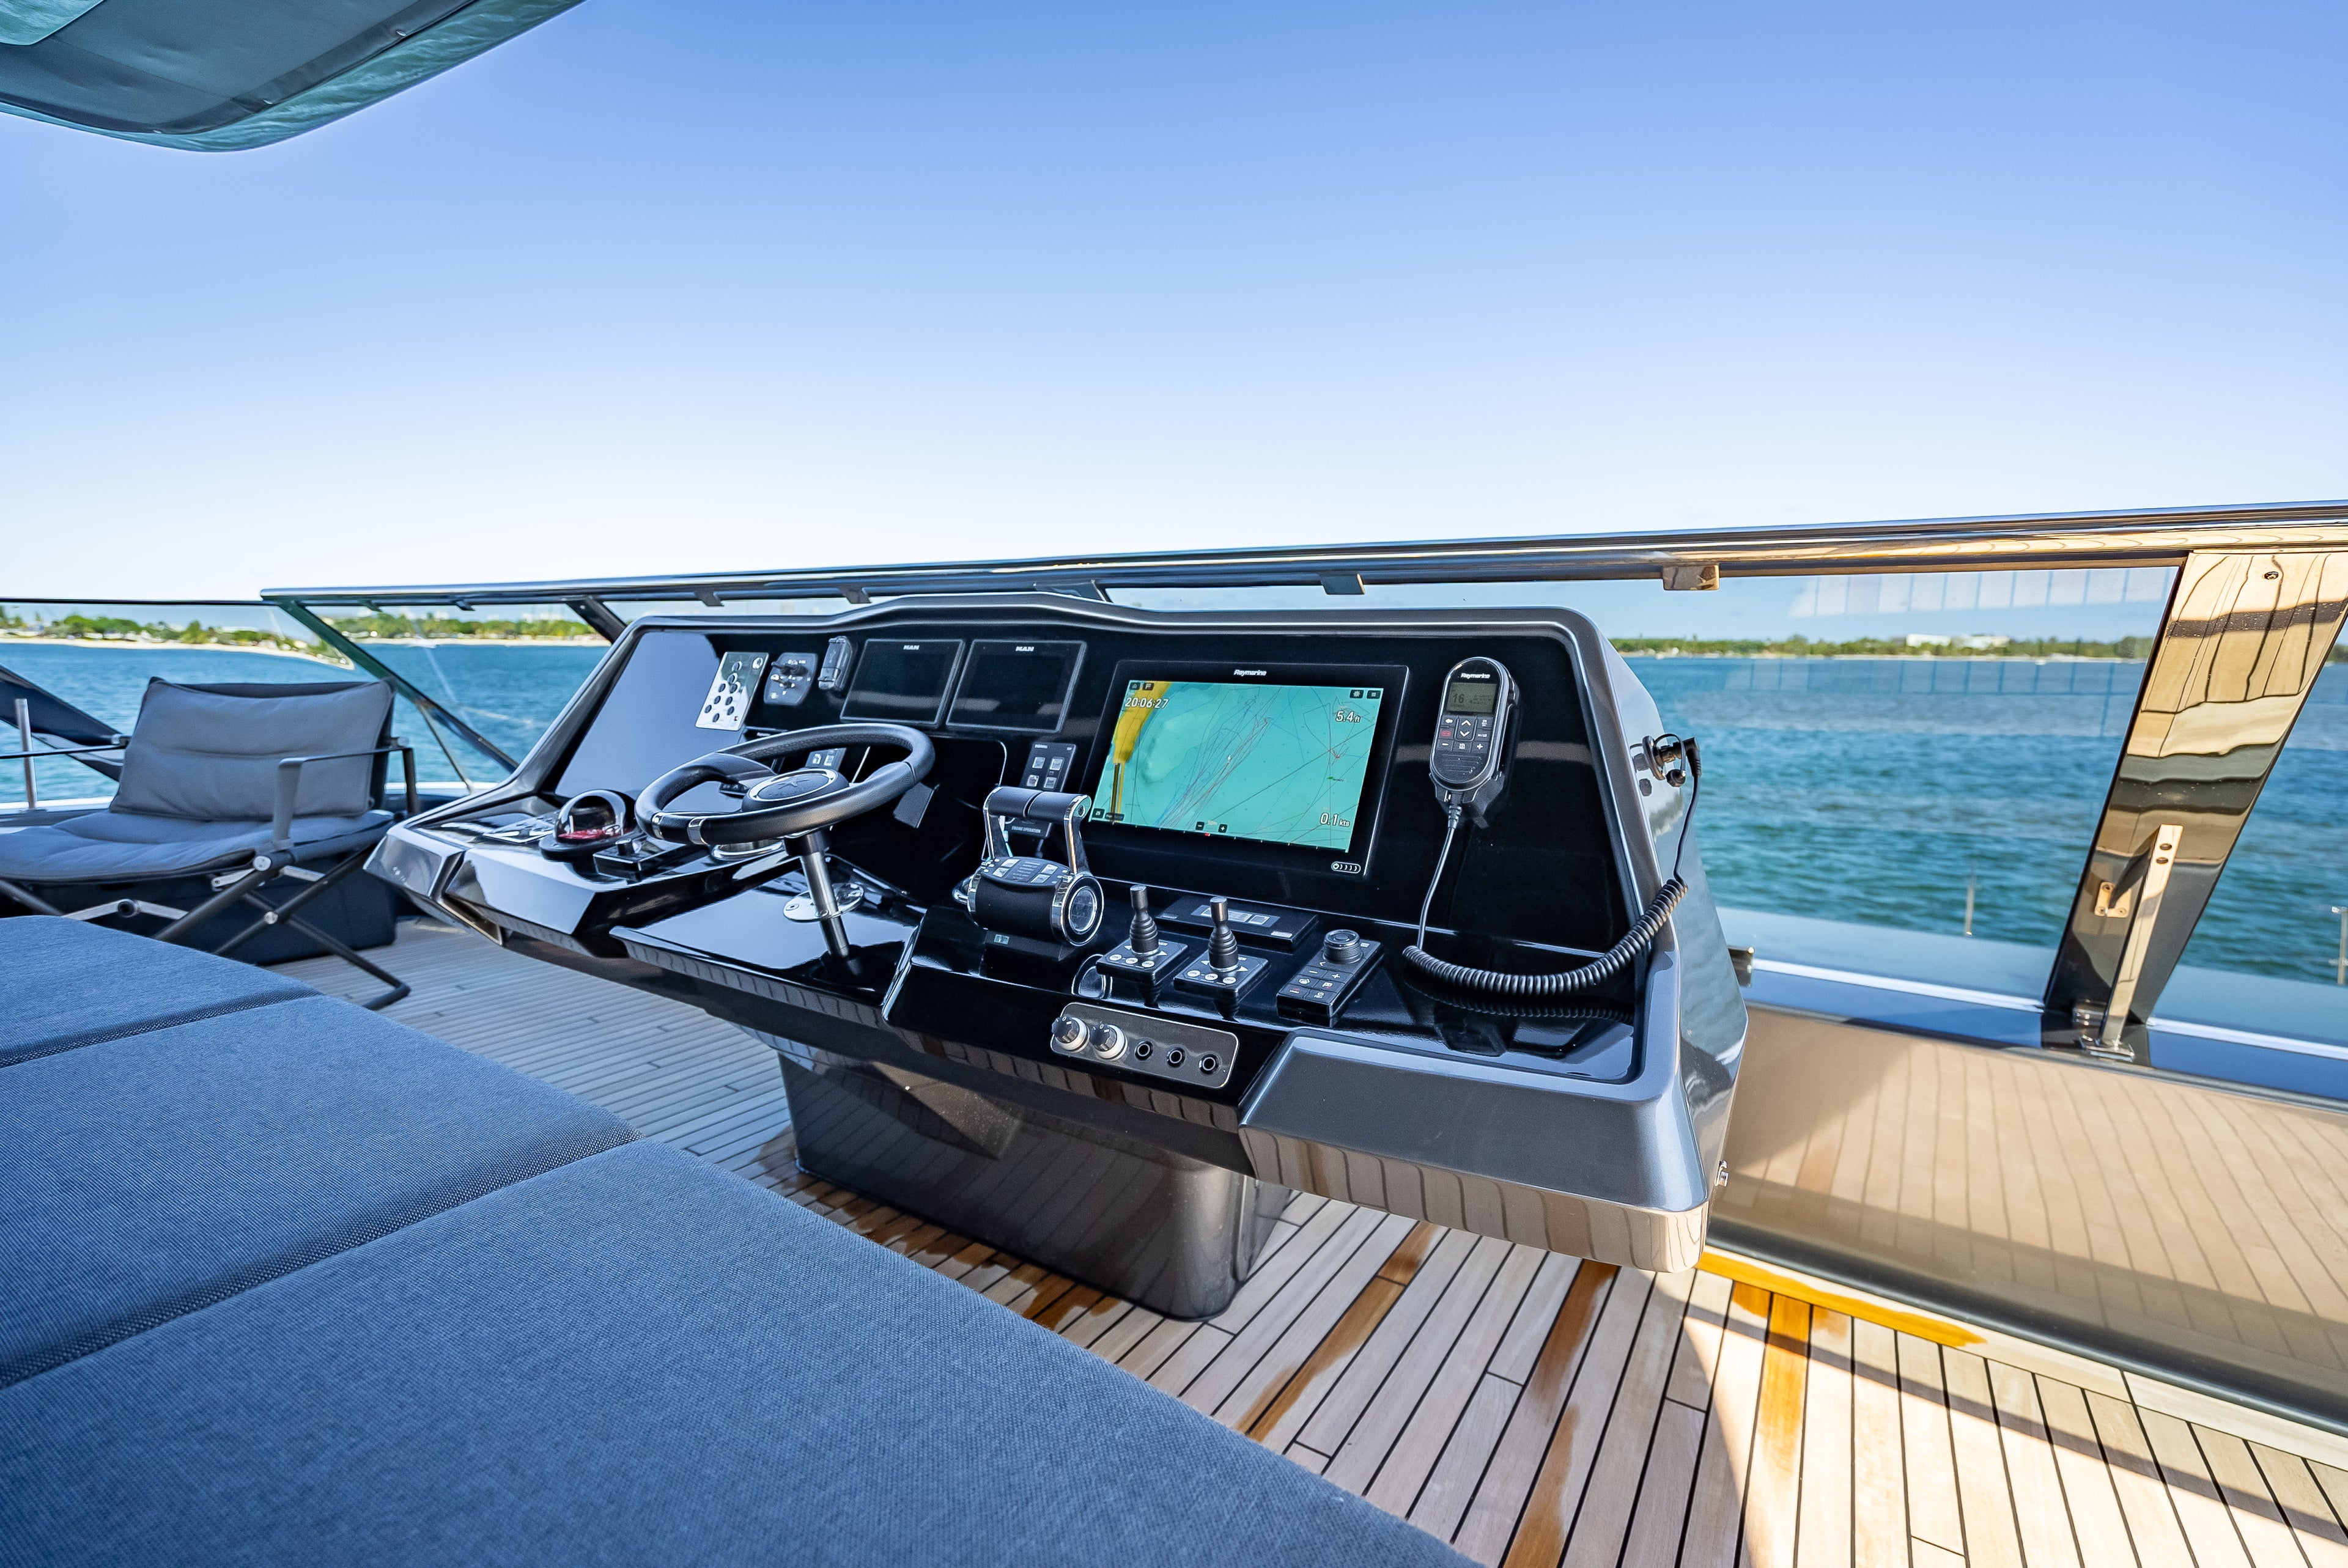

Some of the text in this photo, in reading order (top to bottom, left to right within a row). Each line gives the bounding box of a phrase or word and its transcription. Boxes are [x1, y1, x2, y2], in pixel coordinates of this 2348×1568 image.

[1124, 697, 1169, 709] 20:06:27
[1453, 693, 1465, 704] 16
[1320, 812, 1338, 826] 0.1
